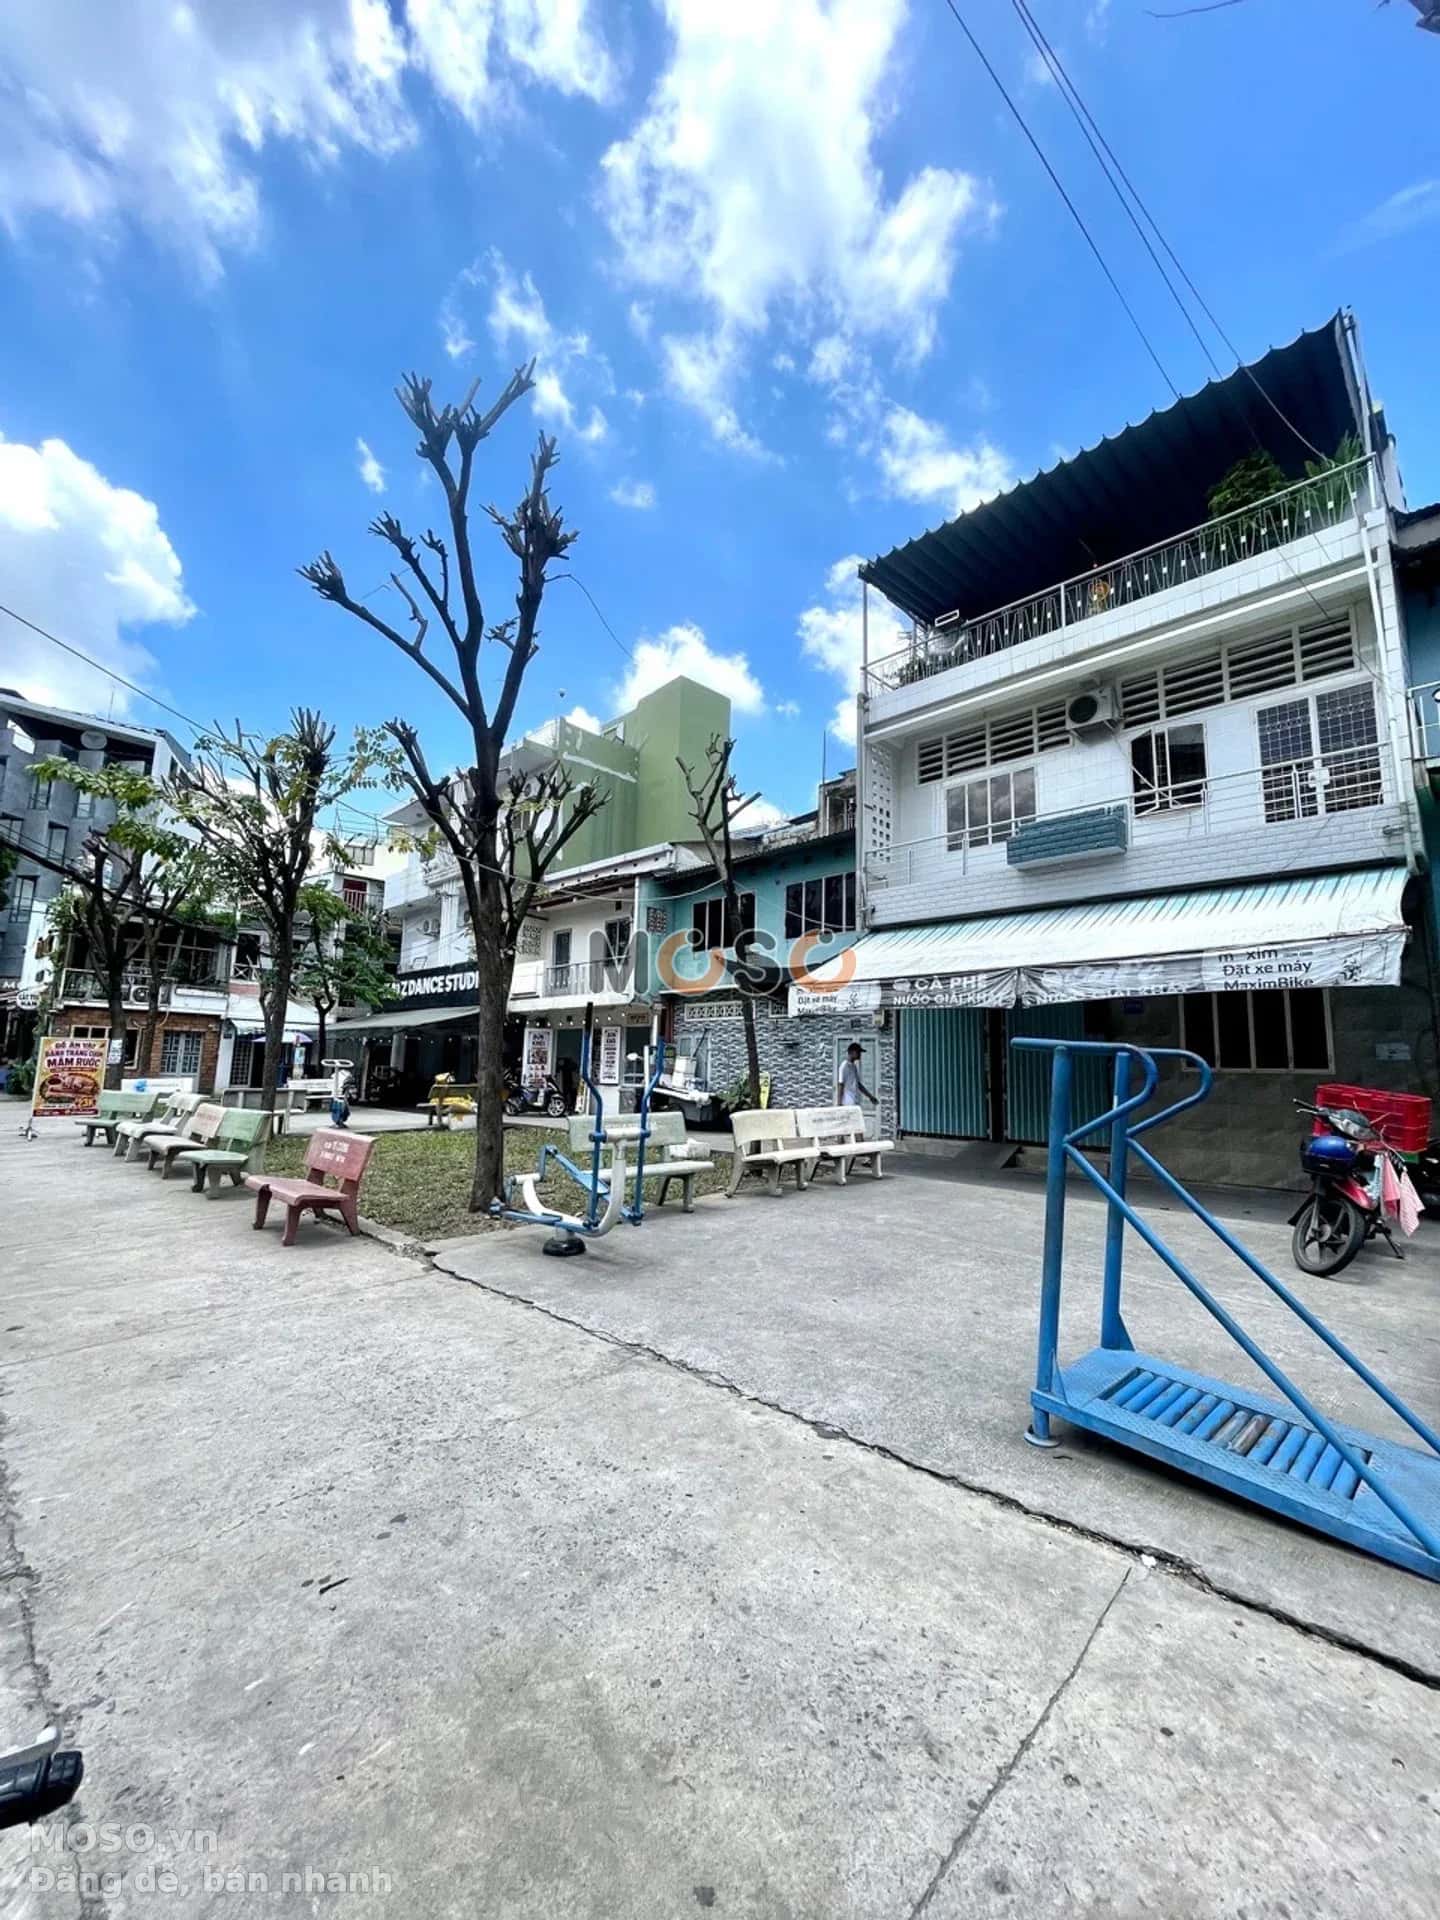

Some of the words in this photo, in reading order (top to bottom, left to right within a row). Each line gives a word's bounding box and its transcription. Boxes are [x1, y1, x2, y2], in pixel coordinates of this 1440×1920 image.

[1223, 964, 1251, 977] Đặt
[1255, 965, 1274, 974] xe
[1278, 960, 1312, 974] máy
[408, 976, 446, 996] DANCE
[445, 970, 480, 992] STUDI
[914, 975, 943, 990] CÀ
